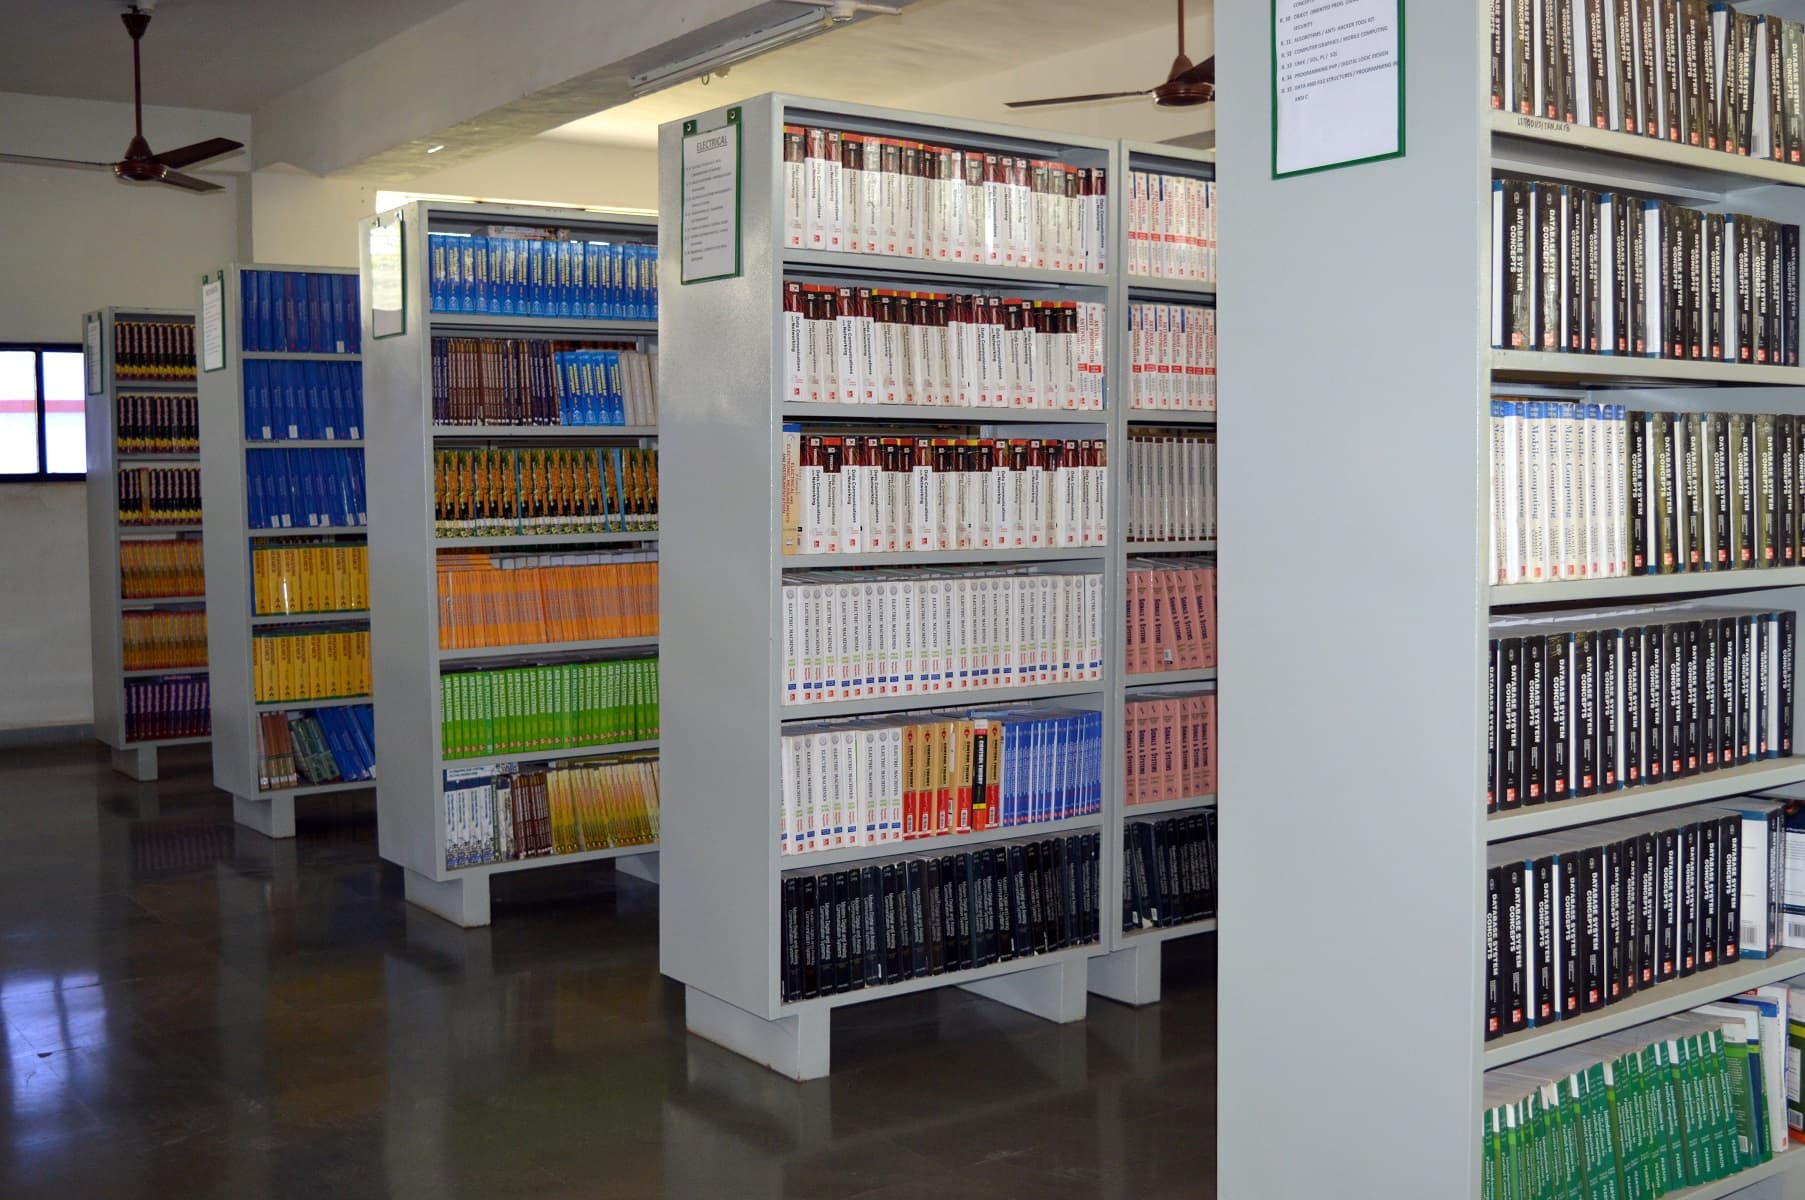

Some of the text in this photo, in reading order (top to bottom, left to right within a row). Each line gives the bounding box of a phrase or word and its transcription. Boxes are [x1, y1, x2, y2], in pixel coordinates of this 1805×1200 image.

[1294, 44, 1318, 55] COMPUTER
[1318, 38, 1340, 48] GRAPHICS
[1360, 26, 1389, 38] COMPUTING
[1294, 66, 1328, 78] PROGRAMMING
[1341, 58, 1358, 68] DIGITAL
[1372, 50, 1389, 59] DESIGN
[1326, 72, 1352, 84] STRUCTURES
[1356, 63, 1392, 75] PROGRAMMING
[697, 136, 728, 152] ELECTRICAL
[1516, 208, 1524, 254] DATABASE
[1549, 424, 1557, 518] Mobile Computing
[1564, 462, 1572, 518] Computing
[1531, 463, 1540, 519] Computing
[1709, 1095, 1717, 1126] Computing
[1719, 1069, 1730, 1122] Parallel Computing
